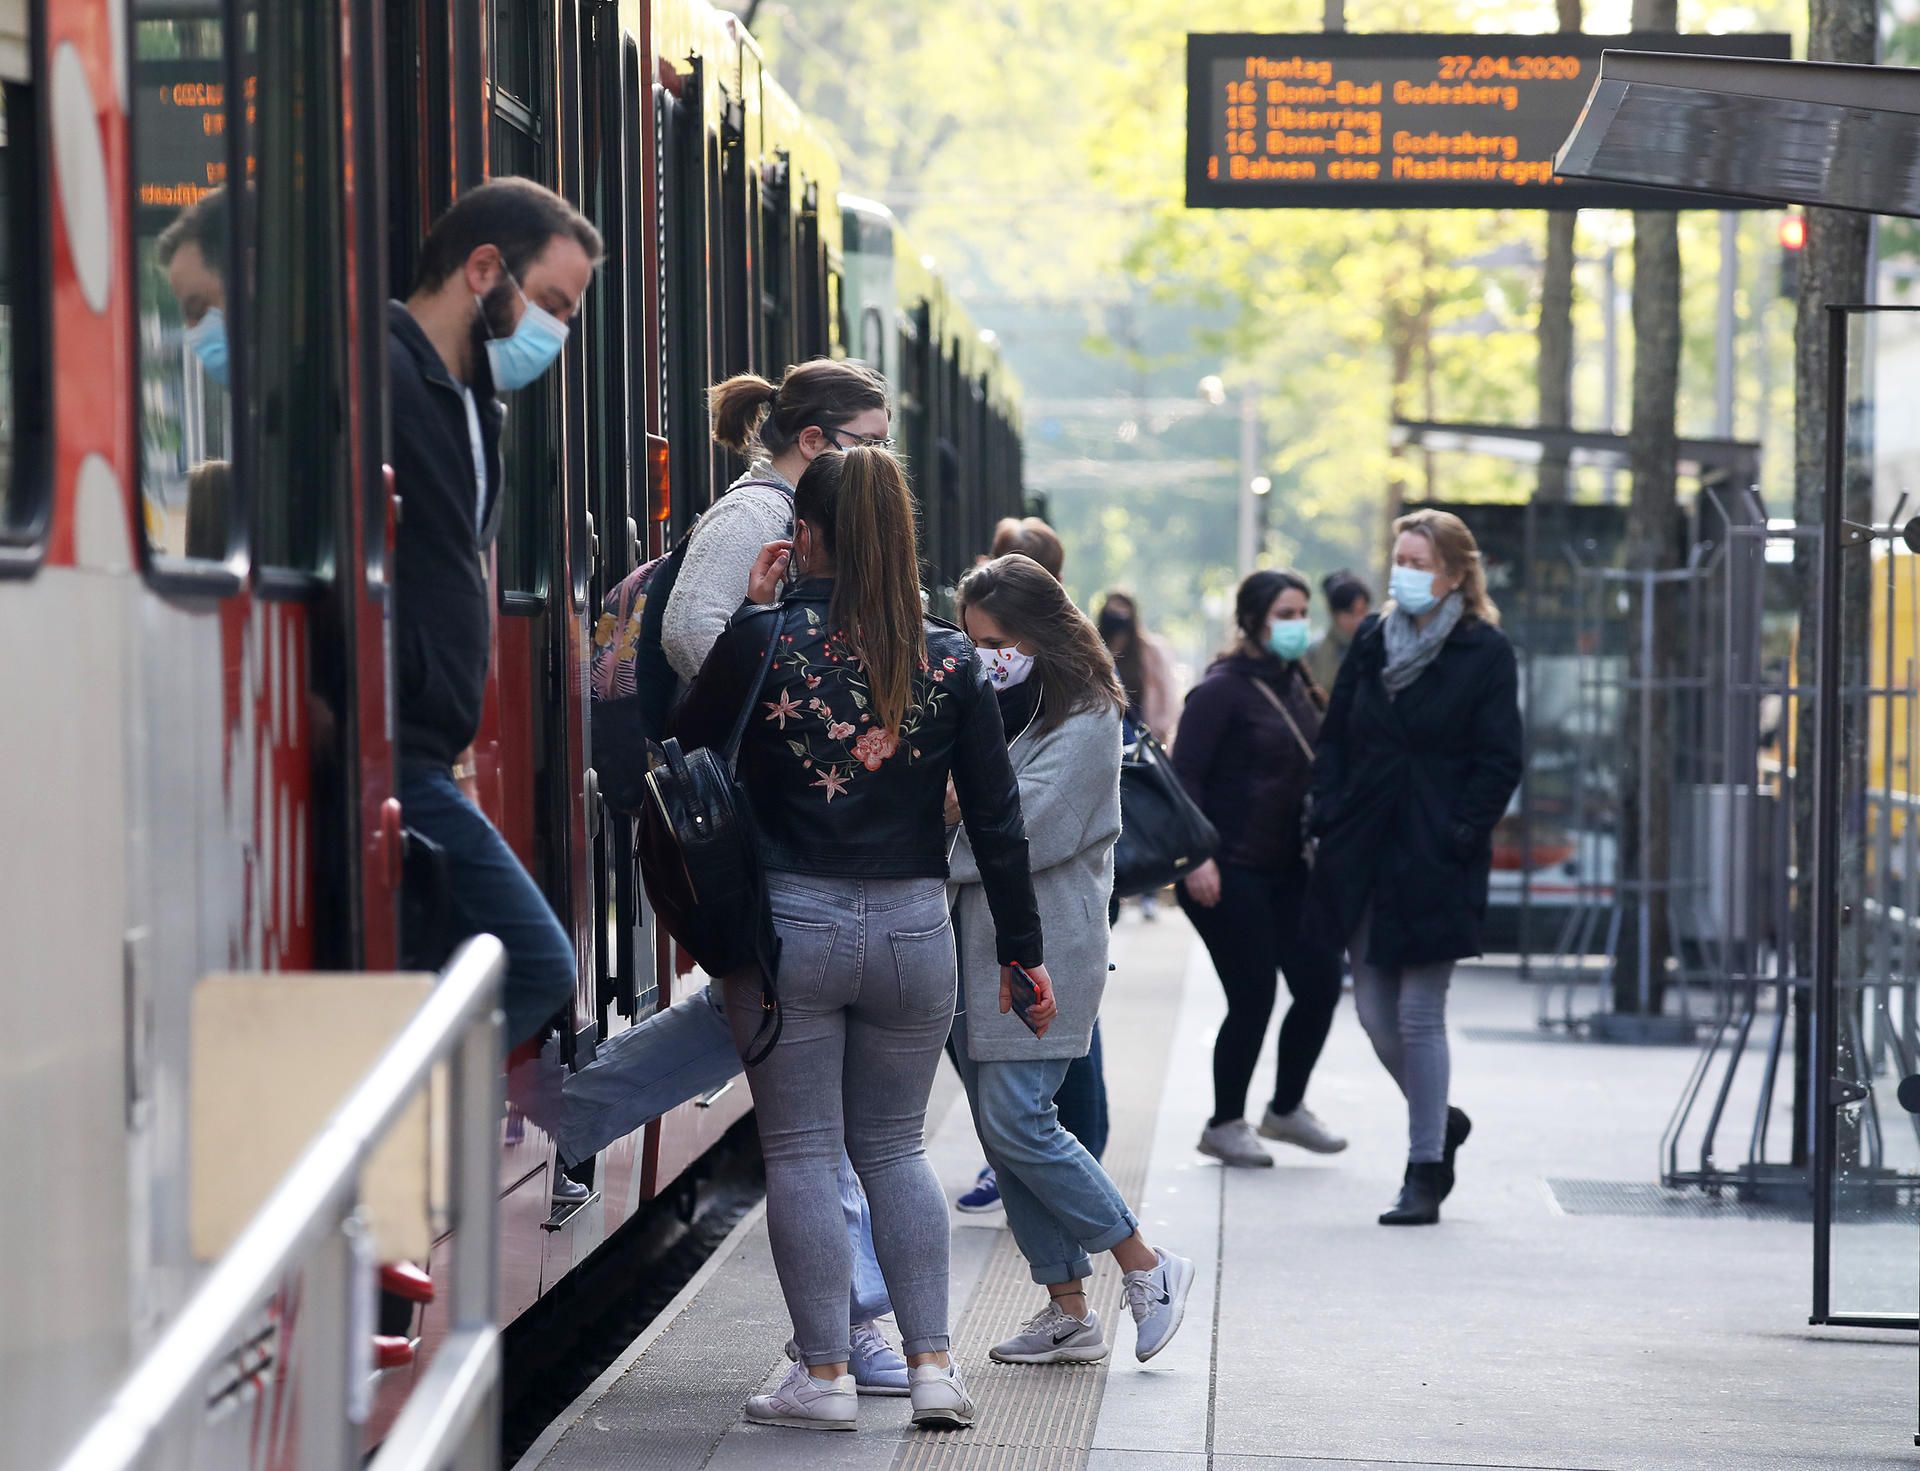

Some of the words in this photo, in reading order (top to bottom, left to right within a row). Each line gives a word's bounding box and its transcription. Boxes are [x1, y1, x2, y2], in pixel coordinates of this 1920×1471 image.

[1246, 55, 1332, 85] Montag
[1438, 55, 1581, 80] 27.04.2020
[1225, 80, 1257, 104] 16
[1266, 80, 1382, 105] Bonn-Bad
[1393, 80, 1518, 110] Godesberg
[1225, 105, 1257, 129] 15
[1266, 105, 1382, 135] Ubierring
[1225, 130, 1257, 154] 16
[1266, 130, 1381, 154] Bonn-Bad
[1393, 130, 1518, 160] Godesberg
[1229, 155, 1316, 179] Bahnen
[1327, 157, 1381, 179] eine
